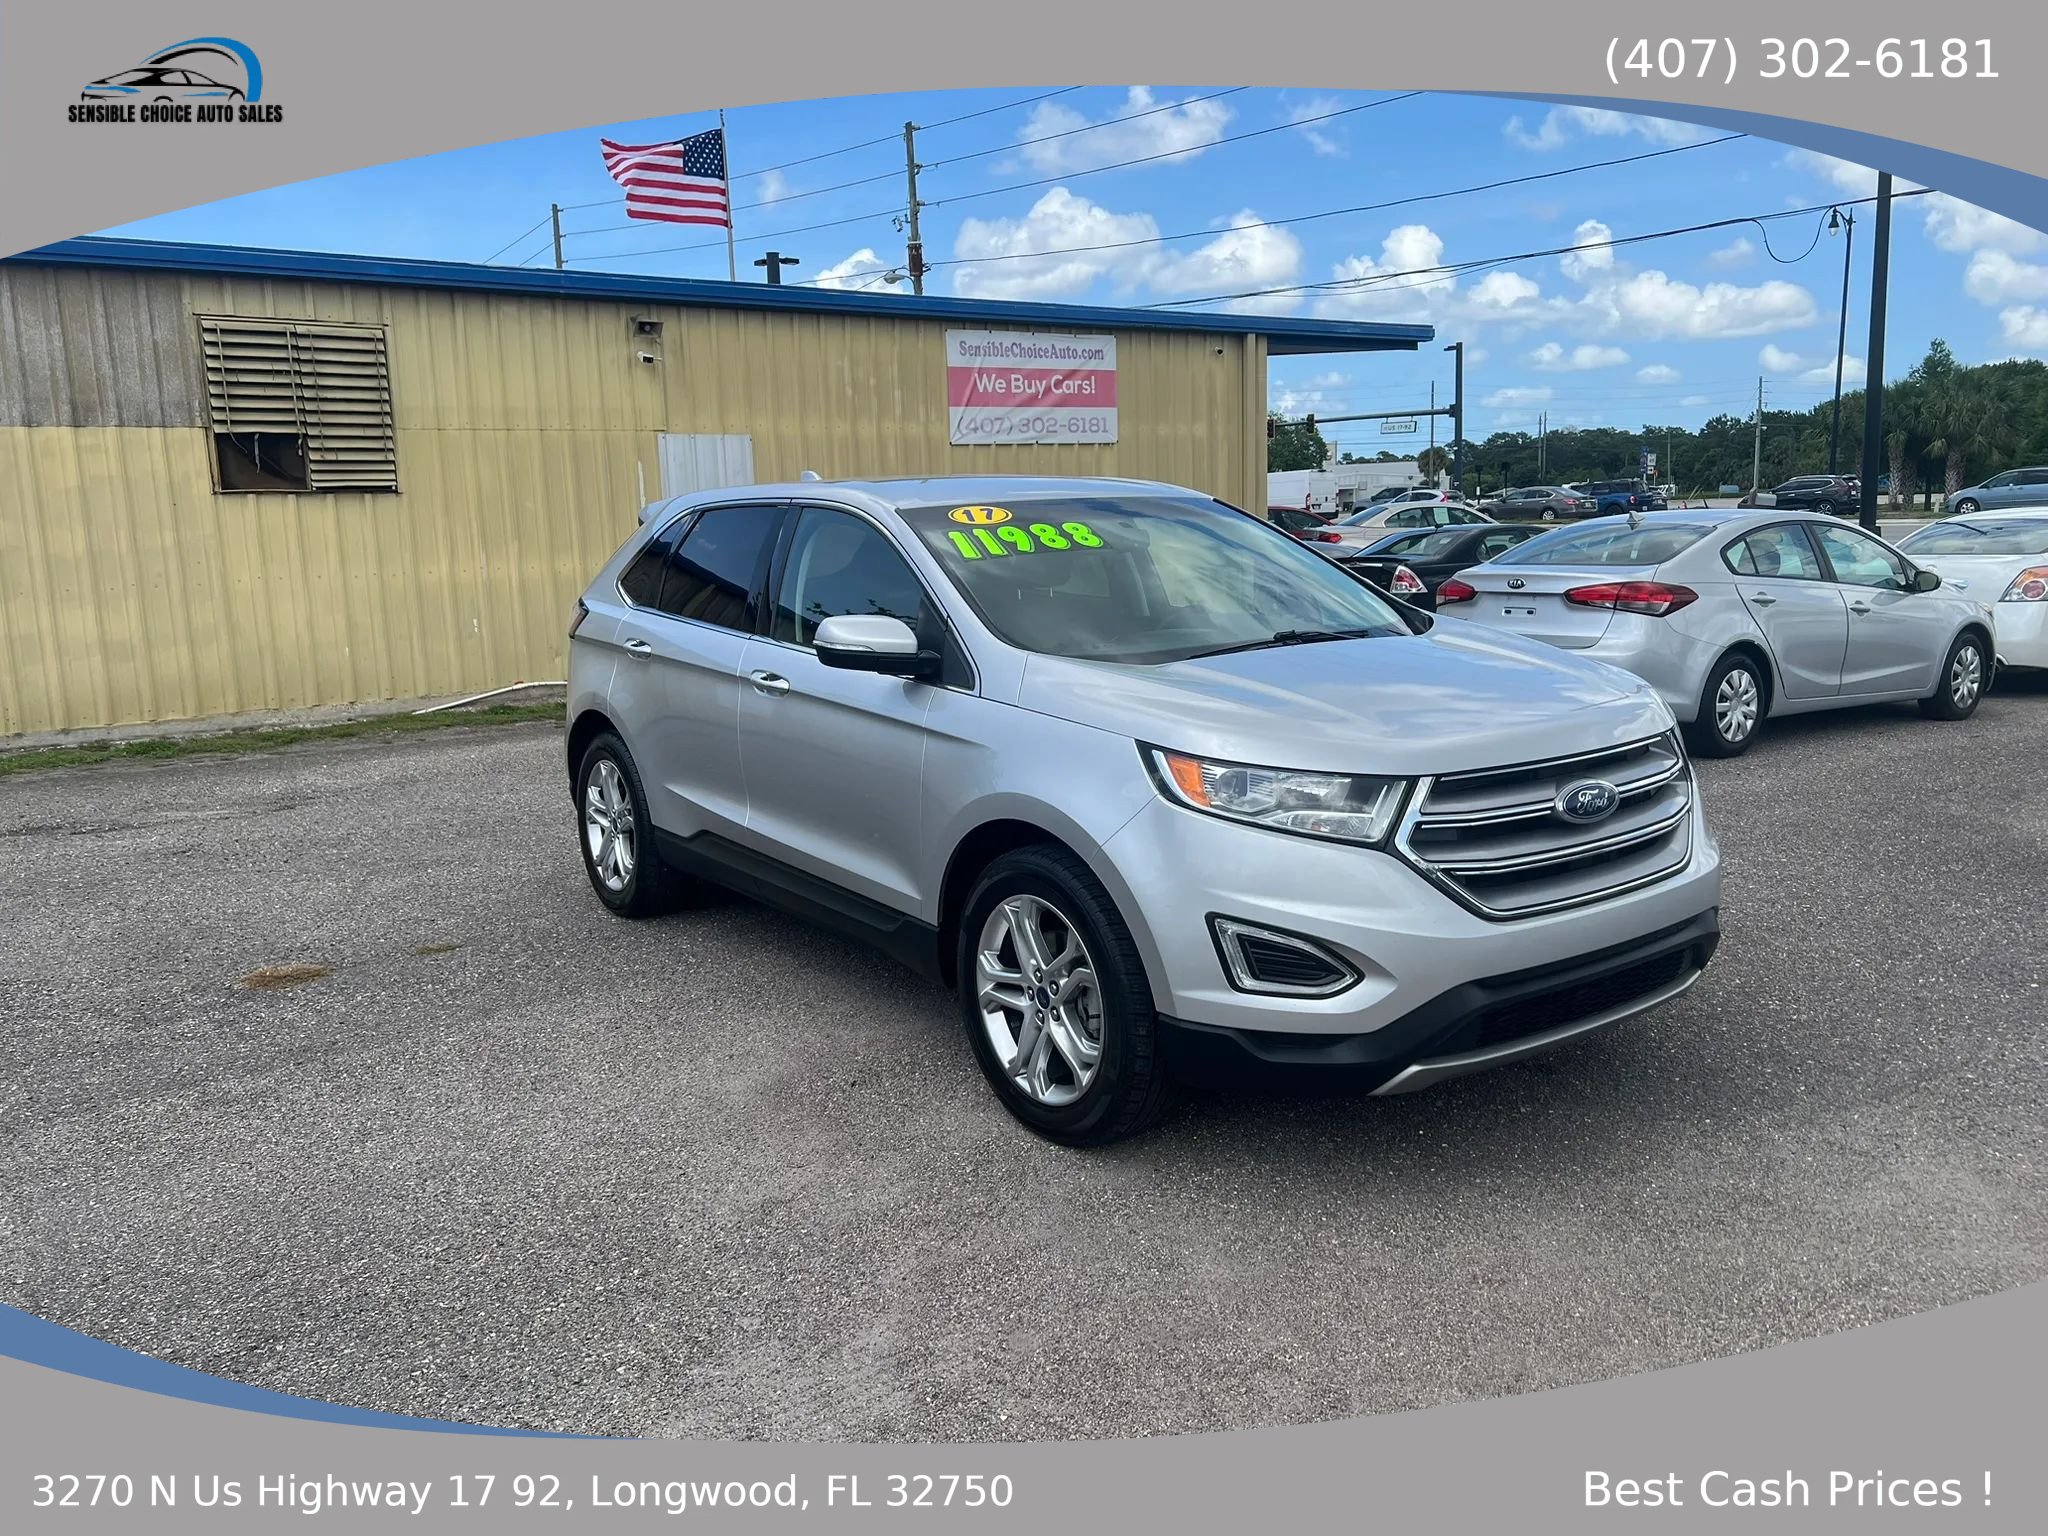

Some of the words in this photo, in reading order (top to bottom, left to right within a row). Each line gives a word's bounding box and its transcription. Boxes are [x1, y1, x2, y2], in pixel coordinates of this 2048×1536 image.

[959, 340, 1105, 361] SensibleChoiceAuto.com
[975, 373, 1006, 394] We
[1010, 374, 1046, 398] Buy
[1051, 375, 1096, 395] Cars!
[957, 416, 1014, 435] (407)
[1018, 416, 1109, 434] 302-6181
[961, 508, 994, 522] 17
[948, 522, 1104, 559] 11988
[1576, 789, 1609, 813] Ford
